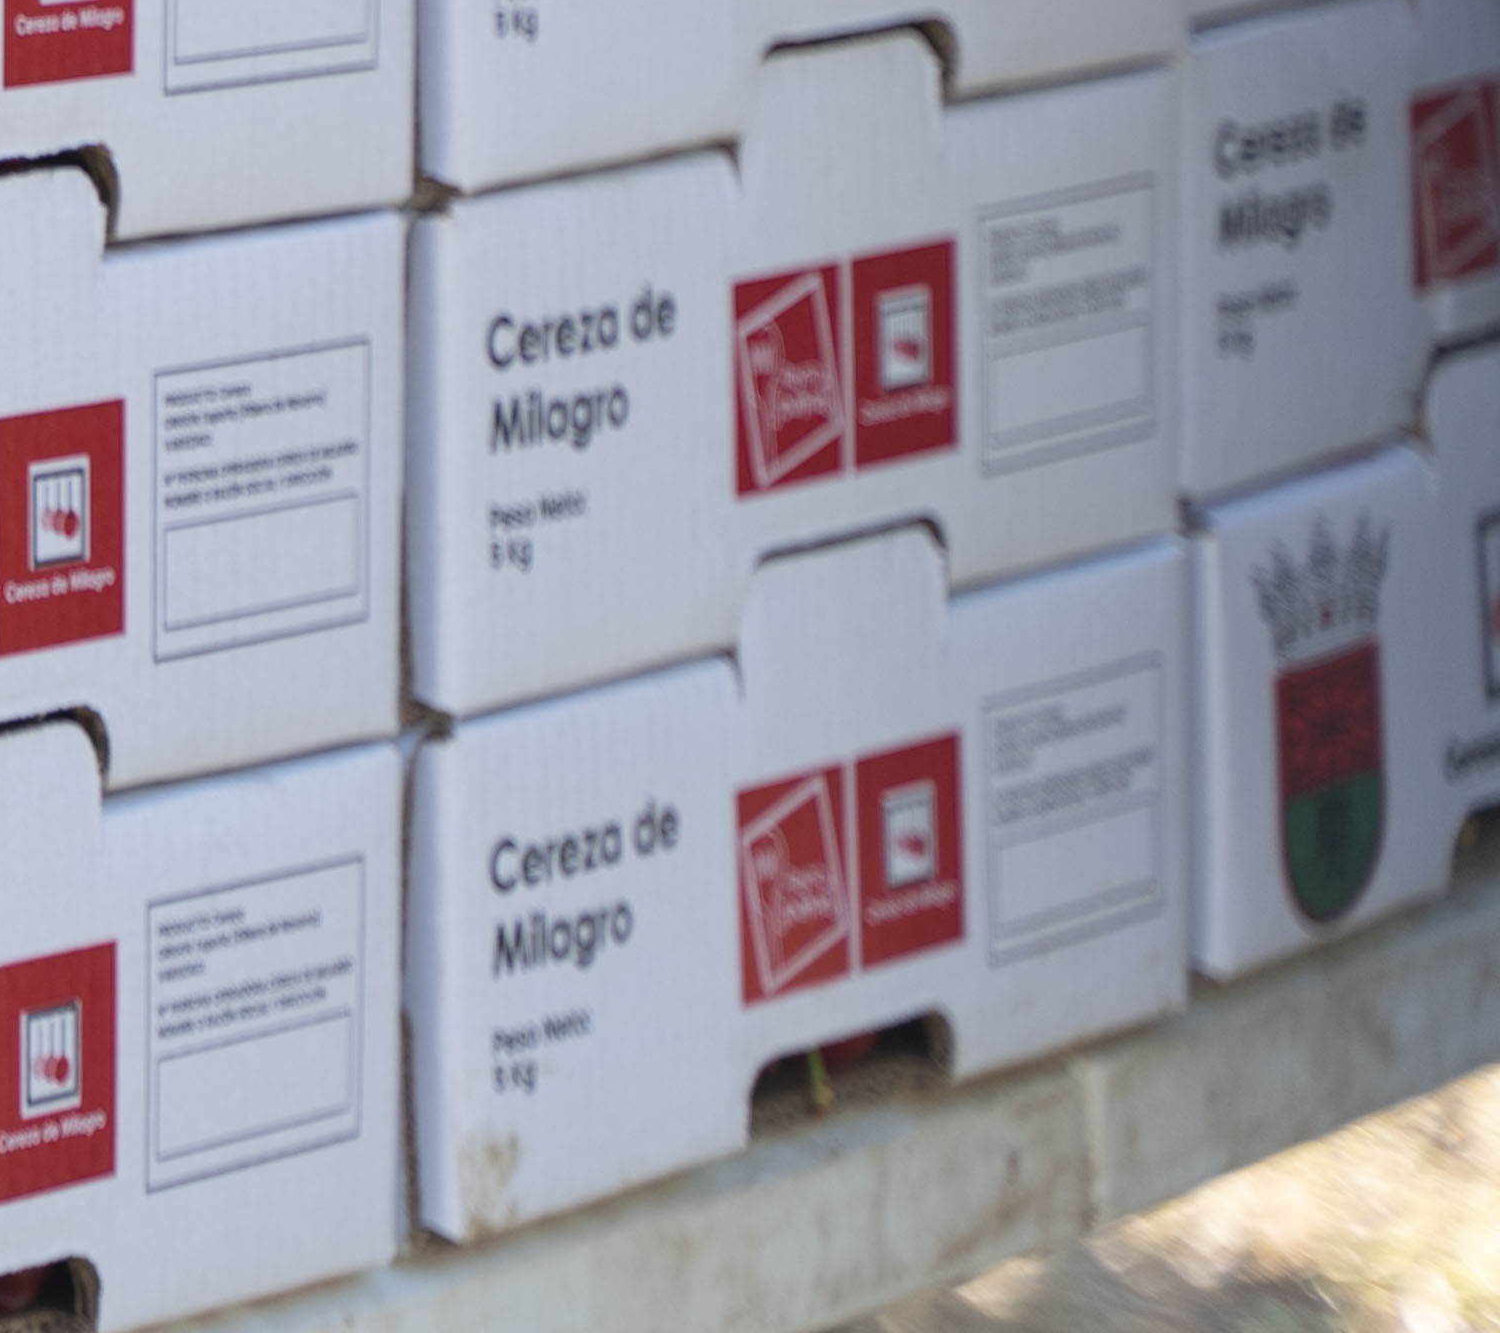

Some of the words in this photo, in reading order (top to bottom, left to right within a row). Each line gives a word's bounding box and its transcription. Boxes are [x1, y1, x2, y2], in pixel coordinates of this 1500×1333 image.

[487, 304, 620, 373] Cereza
[630, 280, 677, 344] de
[489, 382, 630, 455] Milagro
[489, 821, 623, 896] Cereza
[633, 791, 680, 858] de
[492, 897, 634, 981] Milagro
